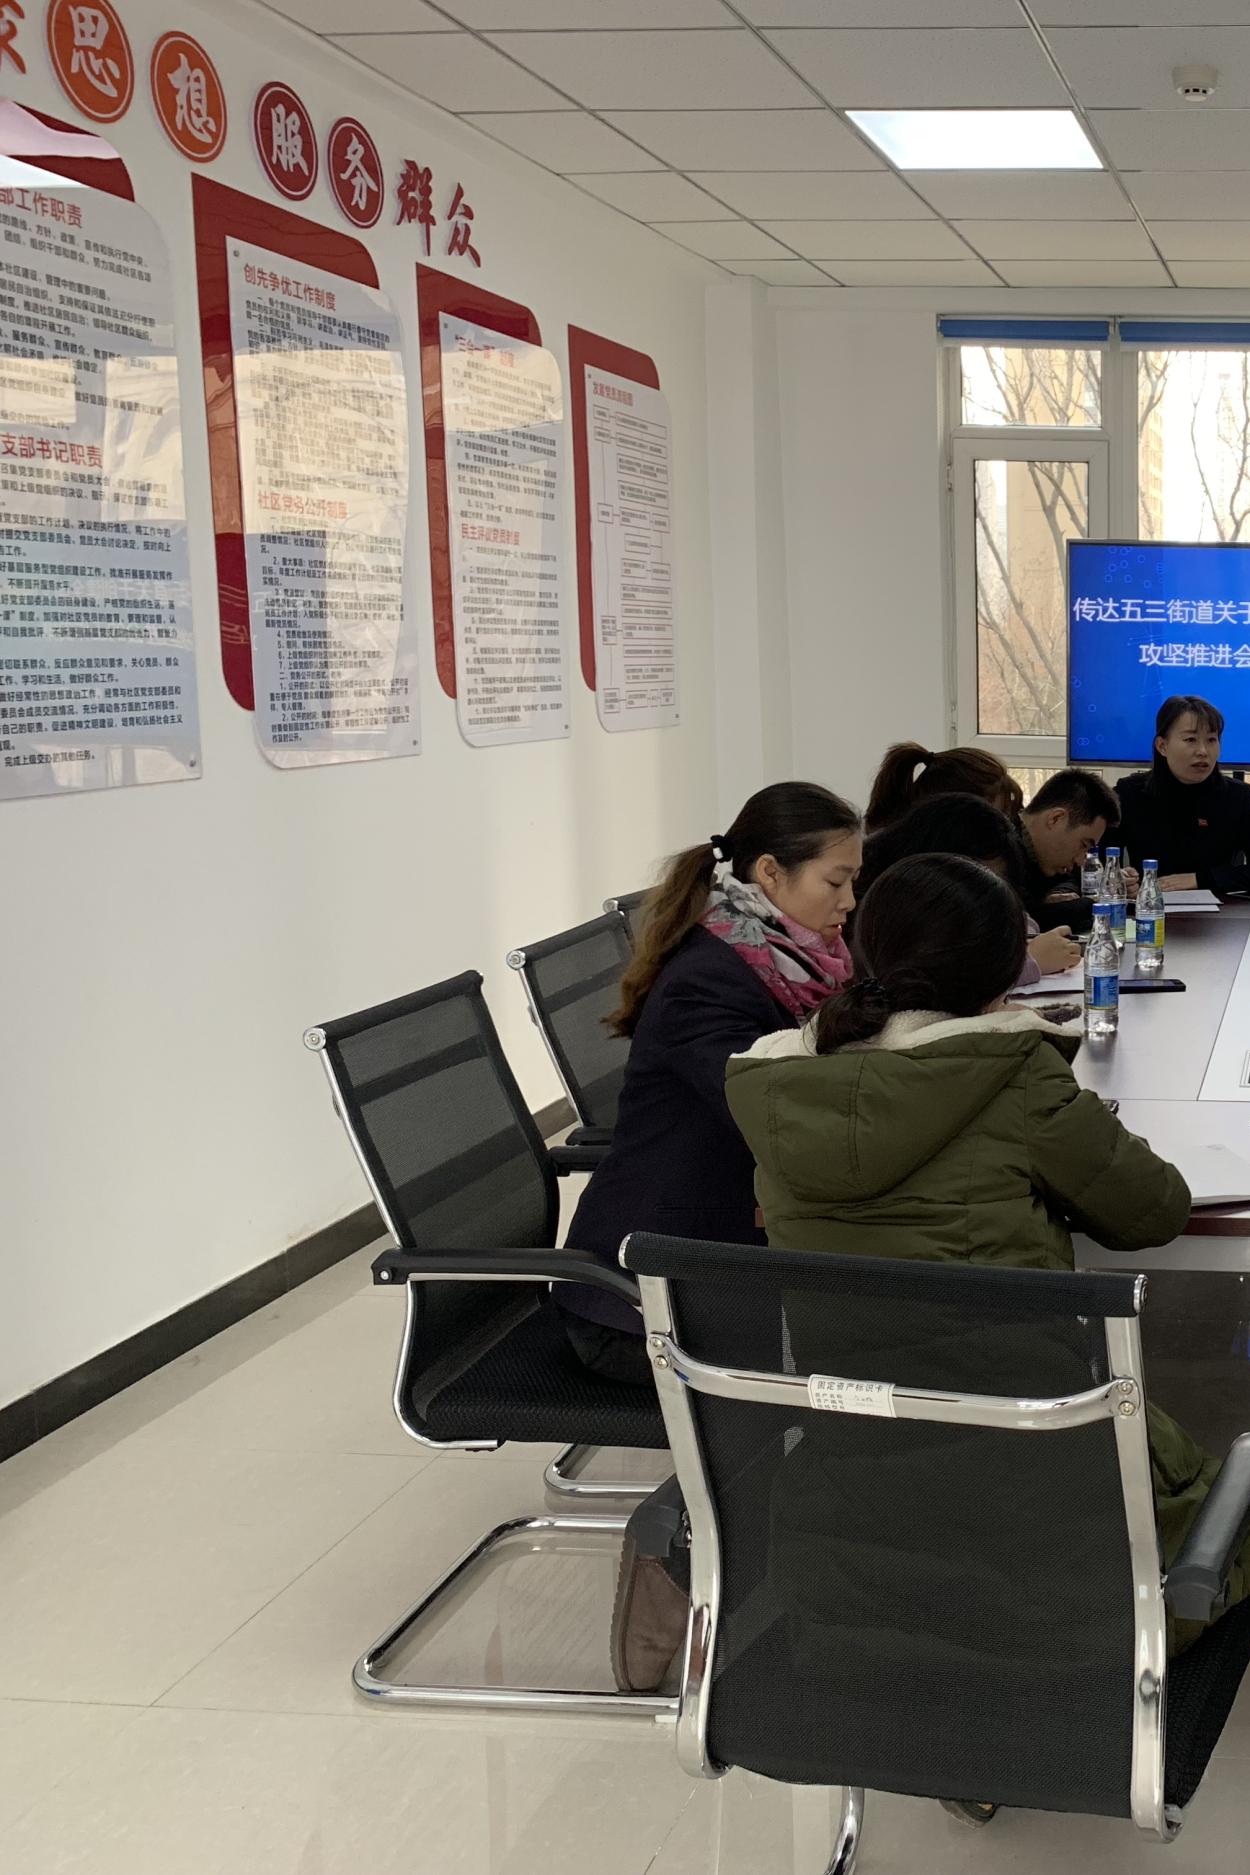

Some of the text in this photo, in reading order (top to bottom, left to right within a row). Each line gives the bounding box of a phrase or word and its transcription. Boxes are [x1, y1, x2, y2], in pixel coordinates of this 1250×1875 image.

[244, 263, 336, 311] 创先争优工作制度
[1, 432, 103, 468] 支部书记职责
